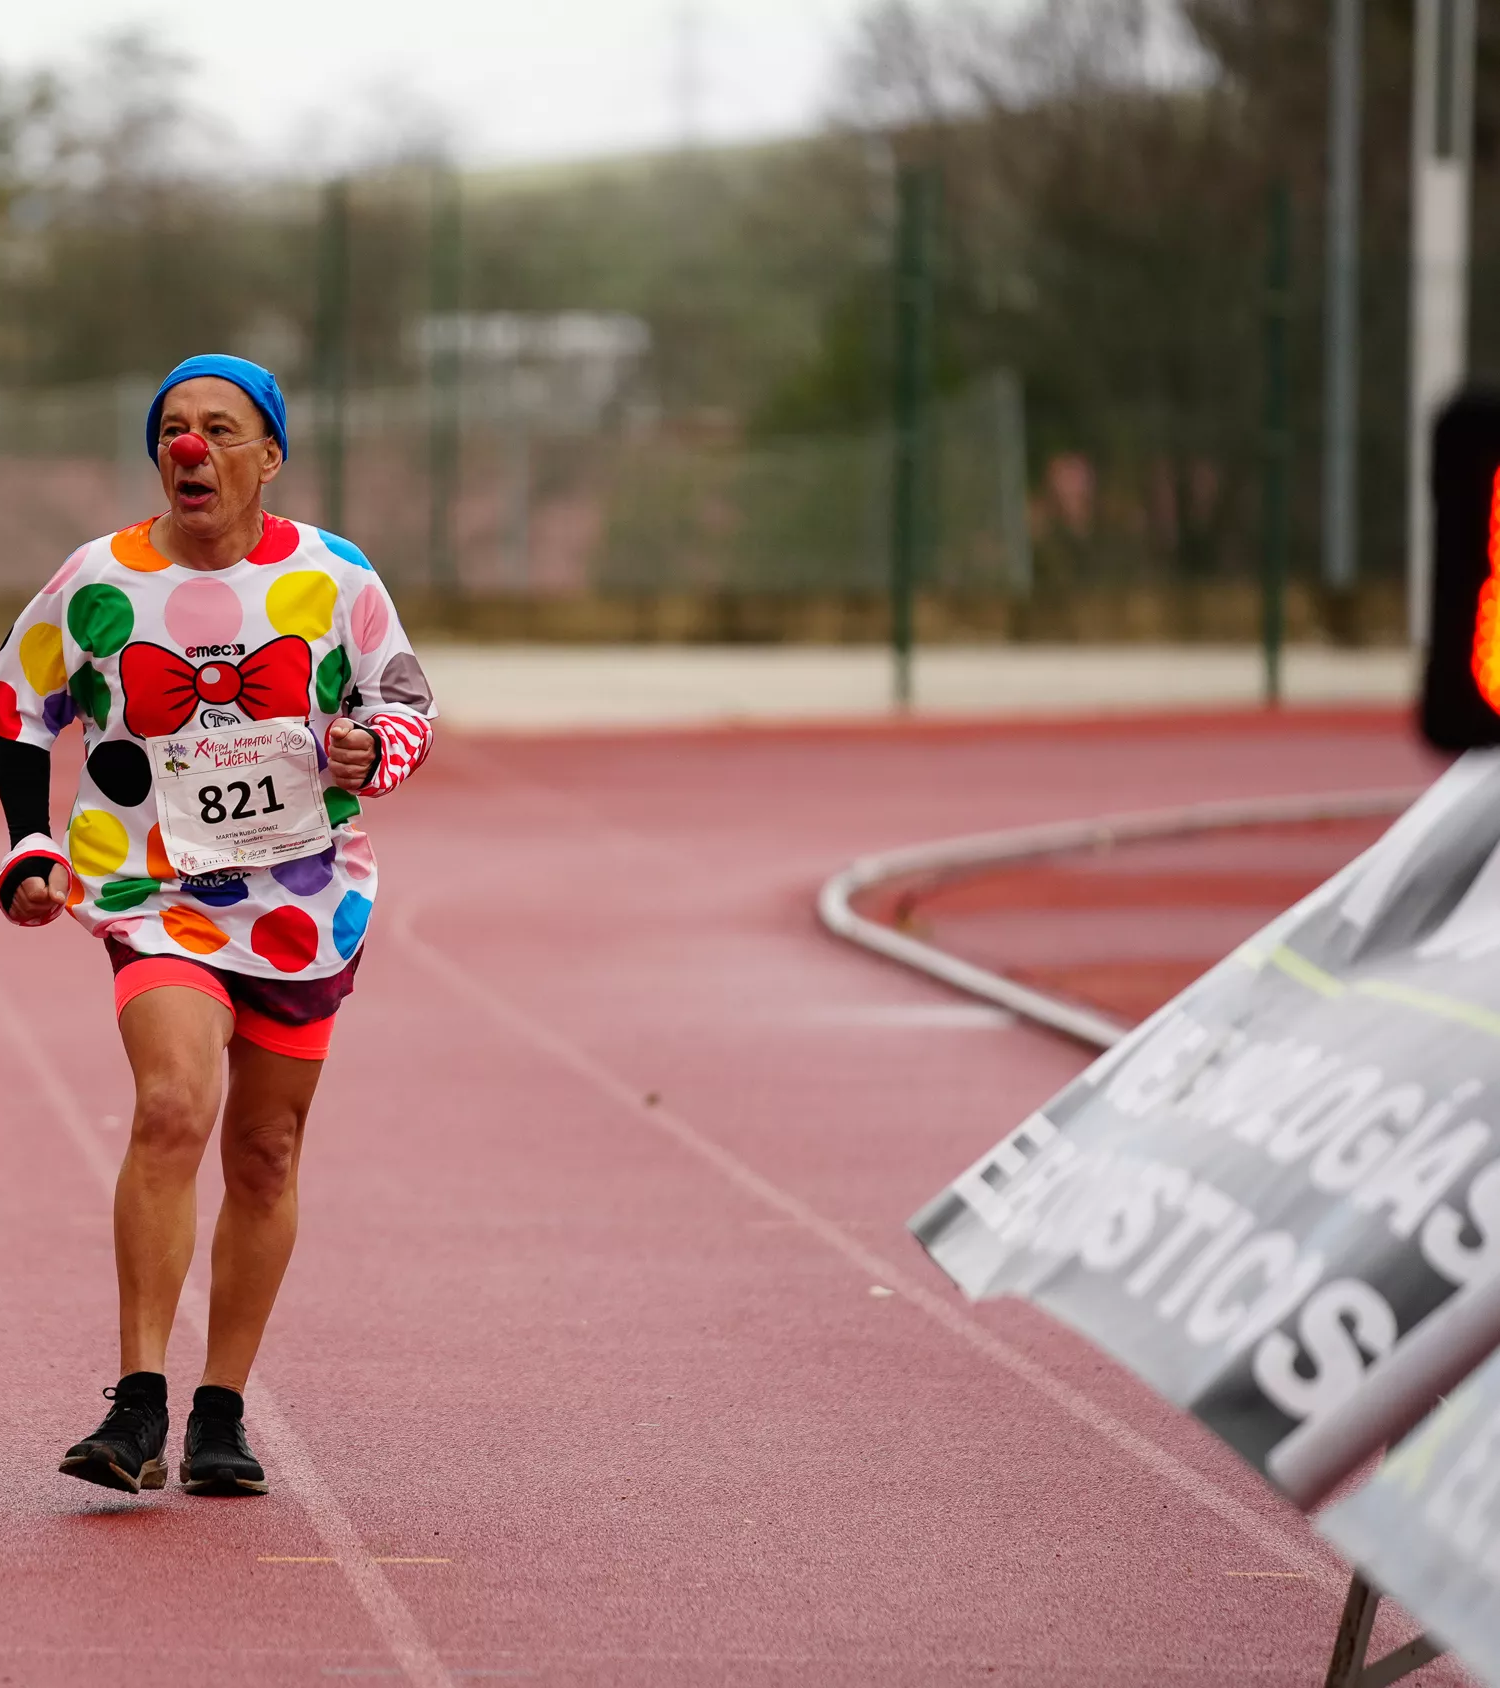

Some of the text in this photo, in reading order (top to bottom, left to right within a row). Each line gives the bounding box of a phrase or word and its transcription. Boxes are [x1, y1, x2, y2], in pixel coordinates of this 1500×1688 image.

[185, 644, 232, 658] emec
[215, 750, 265, 768] LUCENA
[198, 775, 285, 825] 821
[215, 823, 279, 841] MARTÍN RUBIO GÓMEZ
